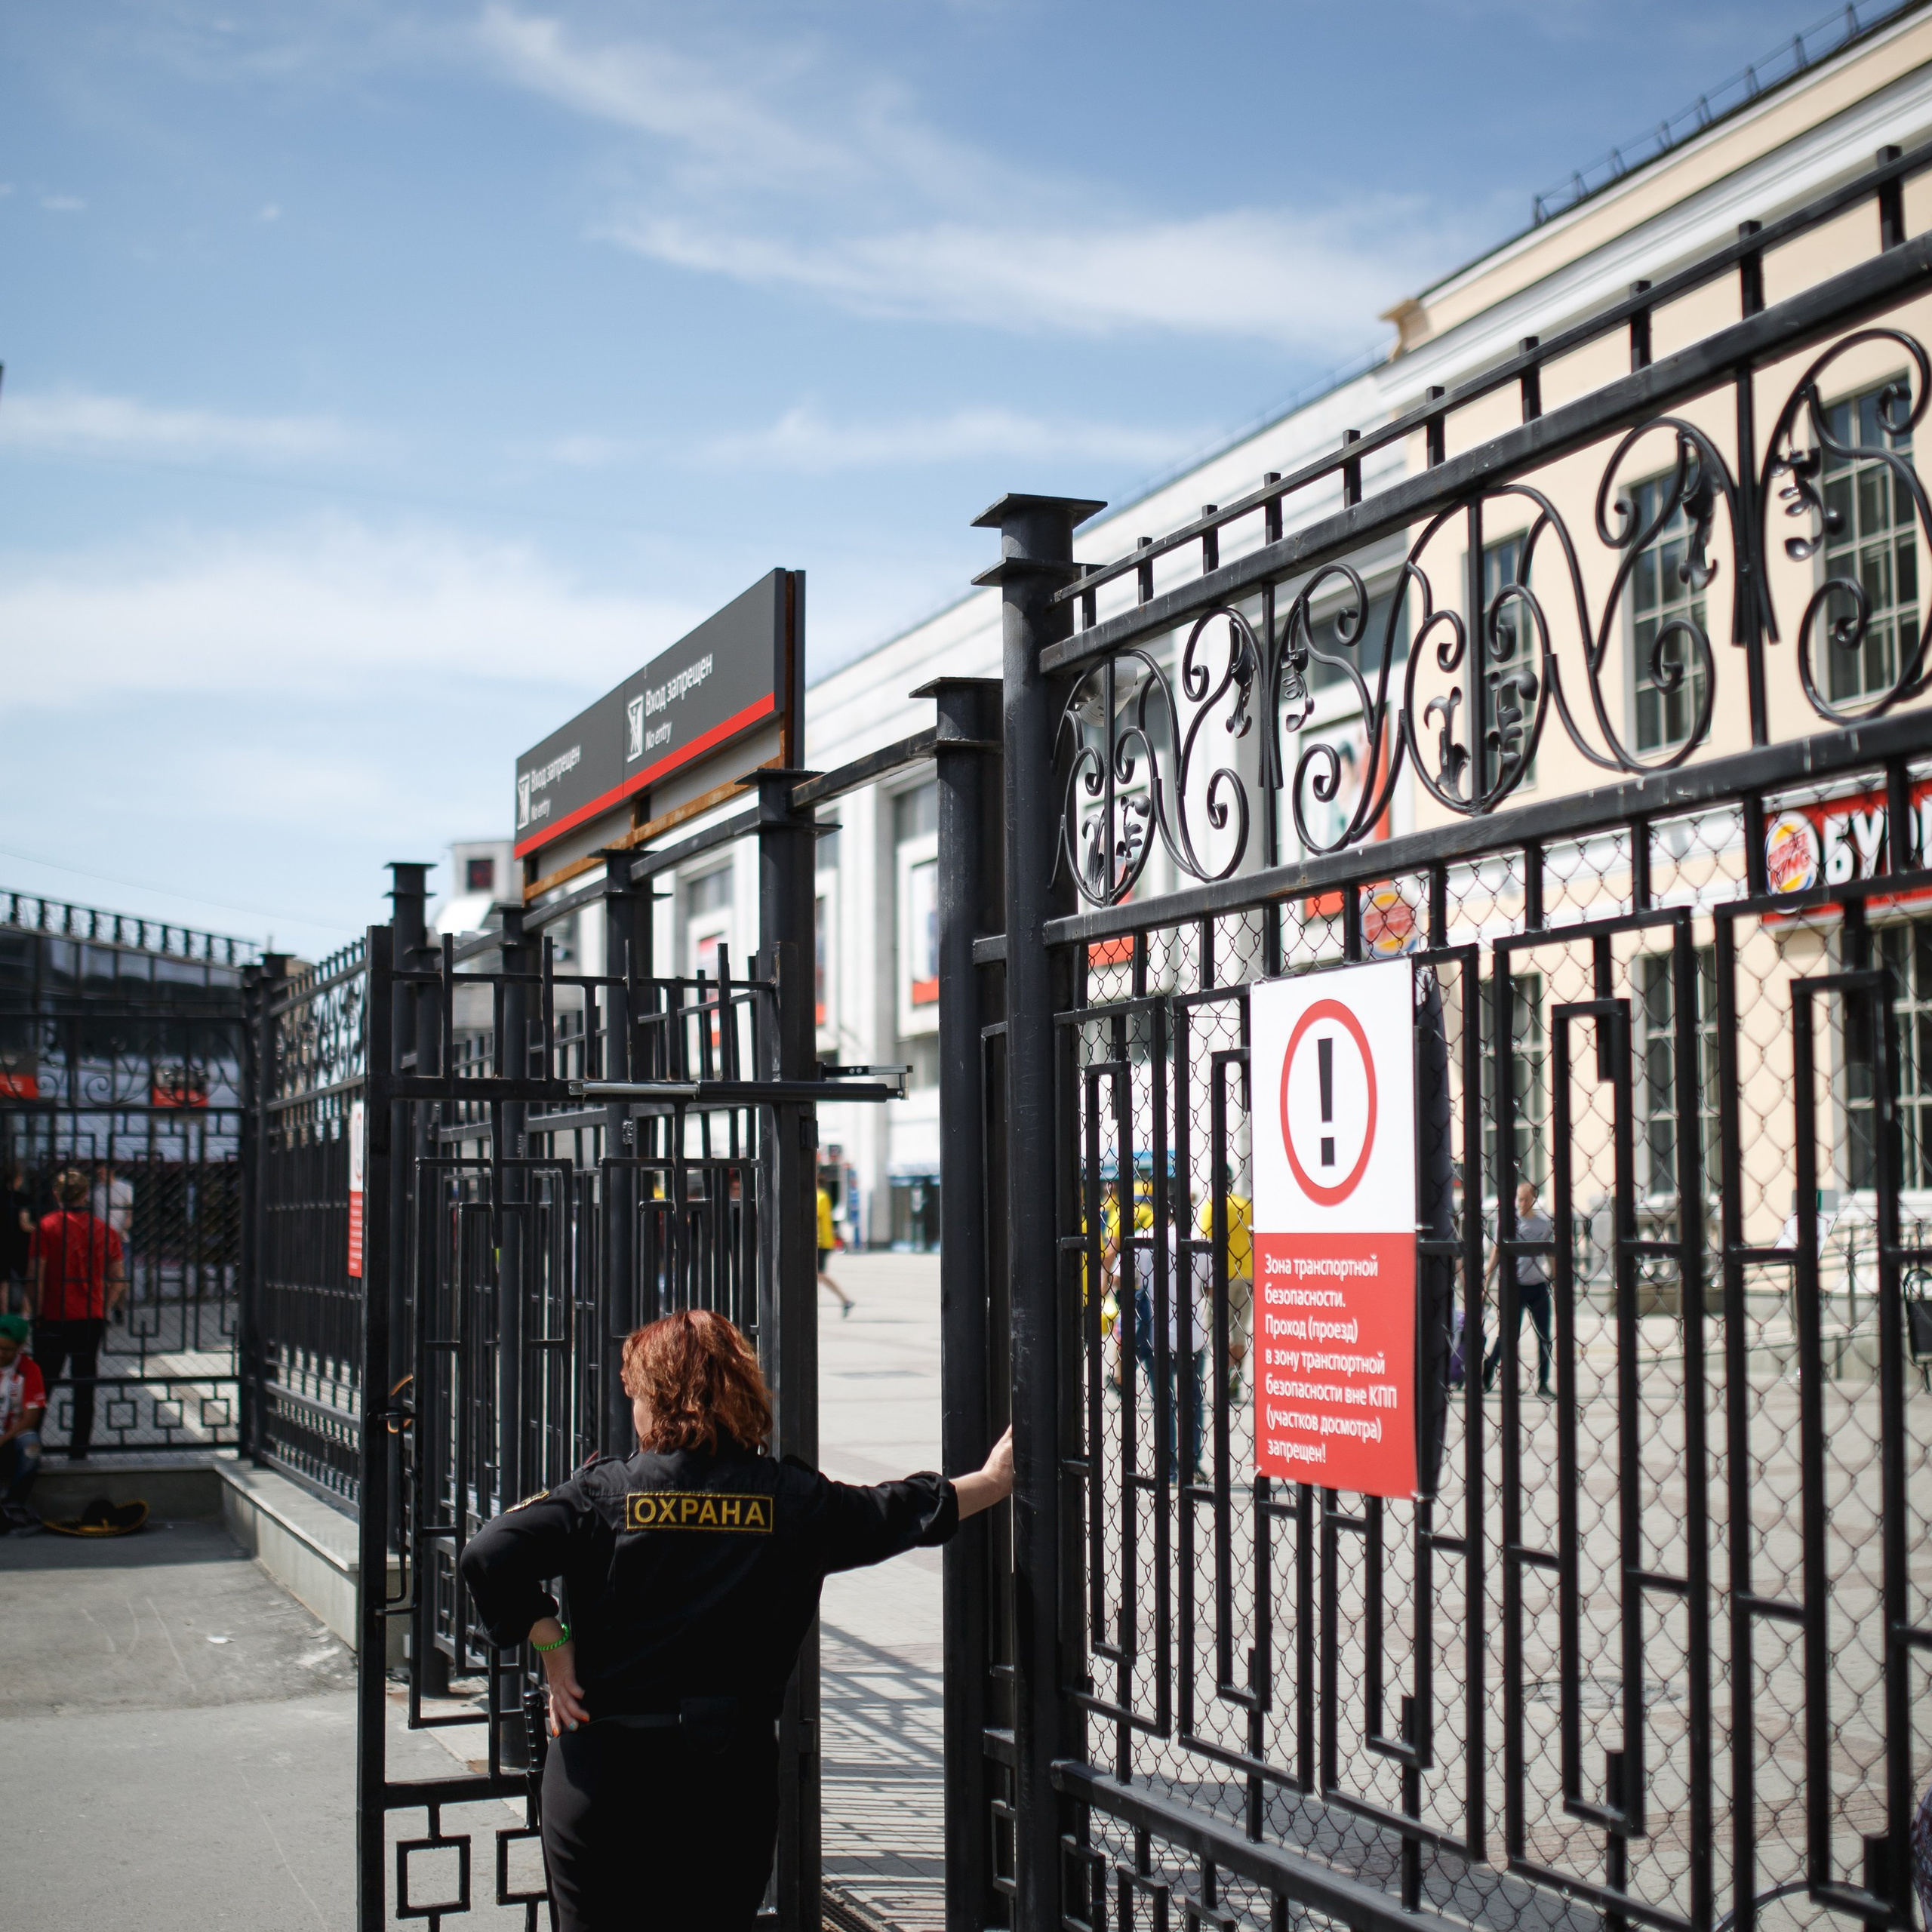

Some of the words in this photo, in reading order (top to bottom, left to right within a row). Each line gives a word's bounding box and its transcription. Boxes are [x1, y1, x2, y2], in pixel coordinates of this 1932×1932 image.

[645, 686, 666, 717] Вход
[667, 653, 713, 701] запрещен
[645, 731, 654, 752] No
[655, 721, 672, 744] entry
[531, 769, 546, 792] Вход
[547, 744, 581, 783] запрещен
[537, 798, 551, 817] entry
[1264, 1254, 1292, 1275] Зона
[1293, 1254, 1378, 1281] транспортной
[1264, 1282, 1346, 1308] безопасности.
[1265, 1315, 1306, 1340] Проход
[1308, 1315, 1358, 1343] (проезд)
[1266, 1349, 1272, 1364] в
[1274, 1351, 1300, 1372] зону
[1302, 1352, 1386, 1376] транспортной
[1266, 1374, 1343, 1402] безопасности
[1346, 1388, 1367, 1406] вне
[1369, 1386, 1397, 1409] КПП
[1266, 1404, 1318, 1431] (участков
[1320, 1416, 1382, 1443] досмотра)
[1268, 1438, 1327, 1465] запрещен!
[635, 1498, 765, 1525] ОХРАНА
